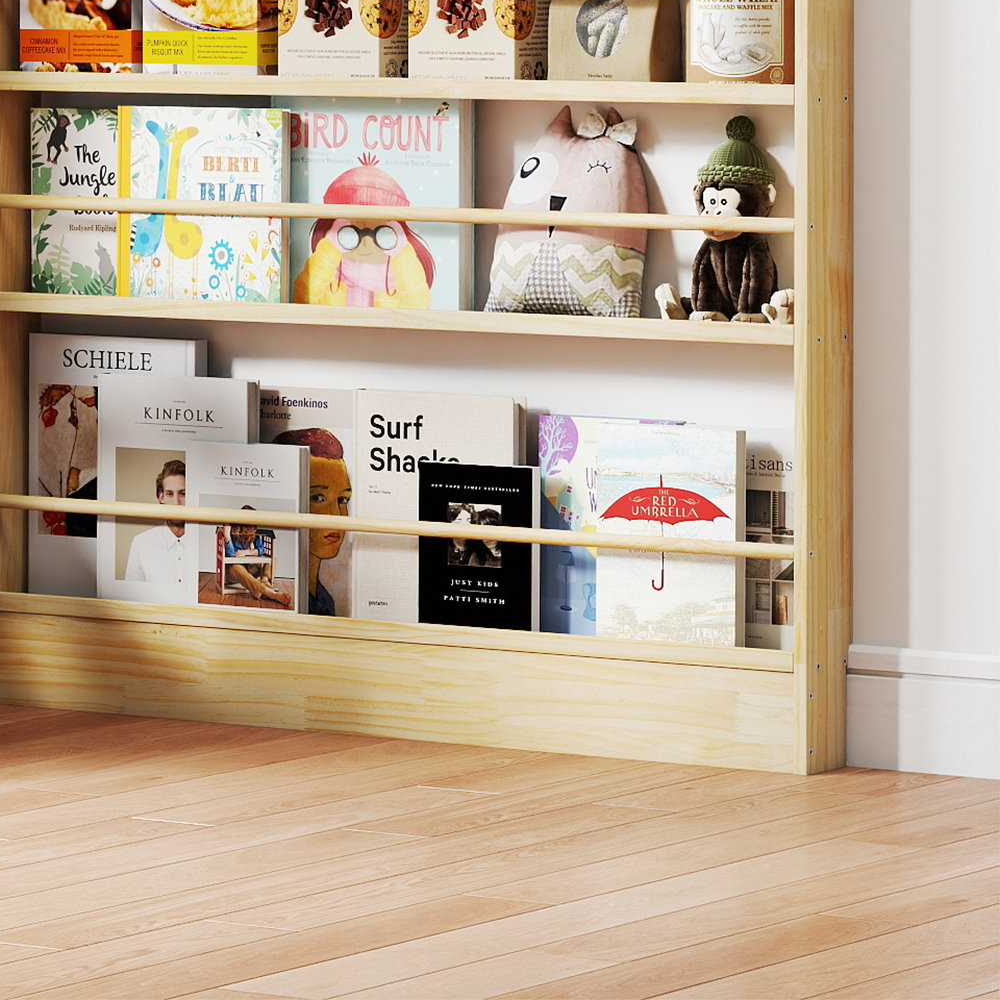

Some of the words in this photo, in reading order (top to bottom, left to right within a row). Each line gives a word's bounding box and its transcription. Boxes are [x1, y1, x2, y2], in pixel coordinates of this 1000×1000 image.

[361, 114, 450, 152] COUNT
[74, 145, 100, 164] The
[201, 156, 260, 173] BERTI
[59, 165, 117, 194] Jungle
[69, 224, 94, 232] Rudyard
[95, 224, 117, 232] Kipling
[62, 348, 153, 371] SCHIELE
[260, 396, 280, 406] avid
[281, 396, 328, 409] Foenkinos
[143, 406, 215, 423] KINFOLK
[260, 409, 291, 420] harlotte
[369, 414, 424, 440] Surf
[745, 454, 793, 471] isans
[220, 465, 275, 479] KINFOLK
[651, 495, 677, 506] RED
[631, 505, 699, 519] UMBRELLA
[450, 578, 473, 587] JUST
[477, 580, 499, 588] KIDS
[443, 595, 471, 603] PATTI
[475, 597, 505, 605] SMITH
